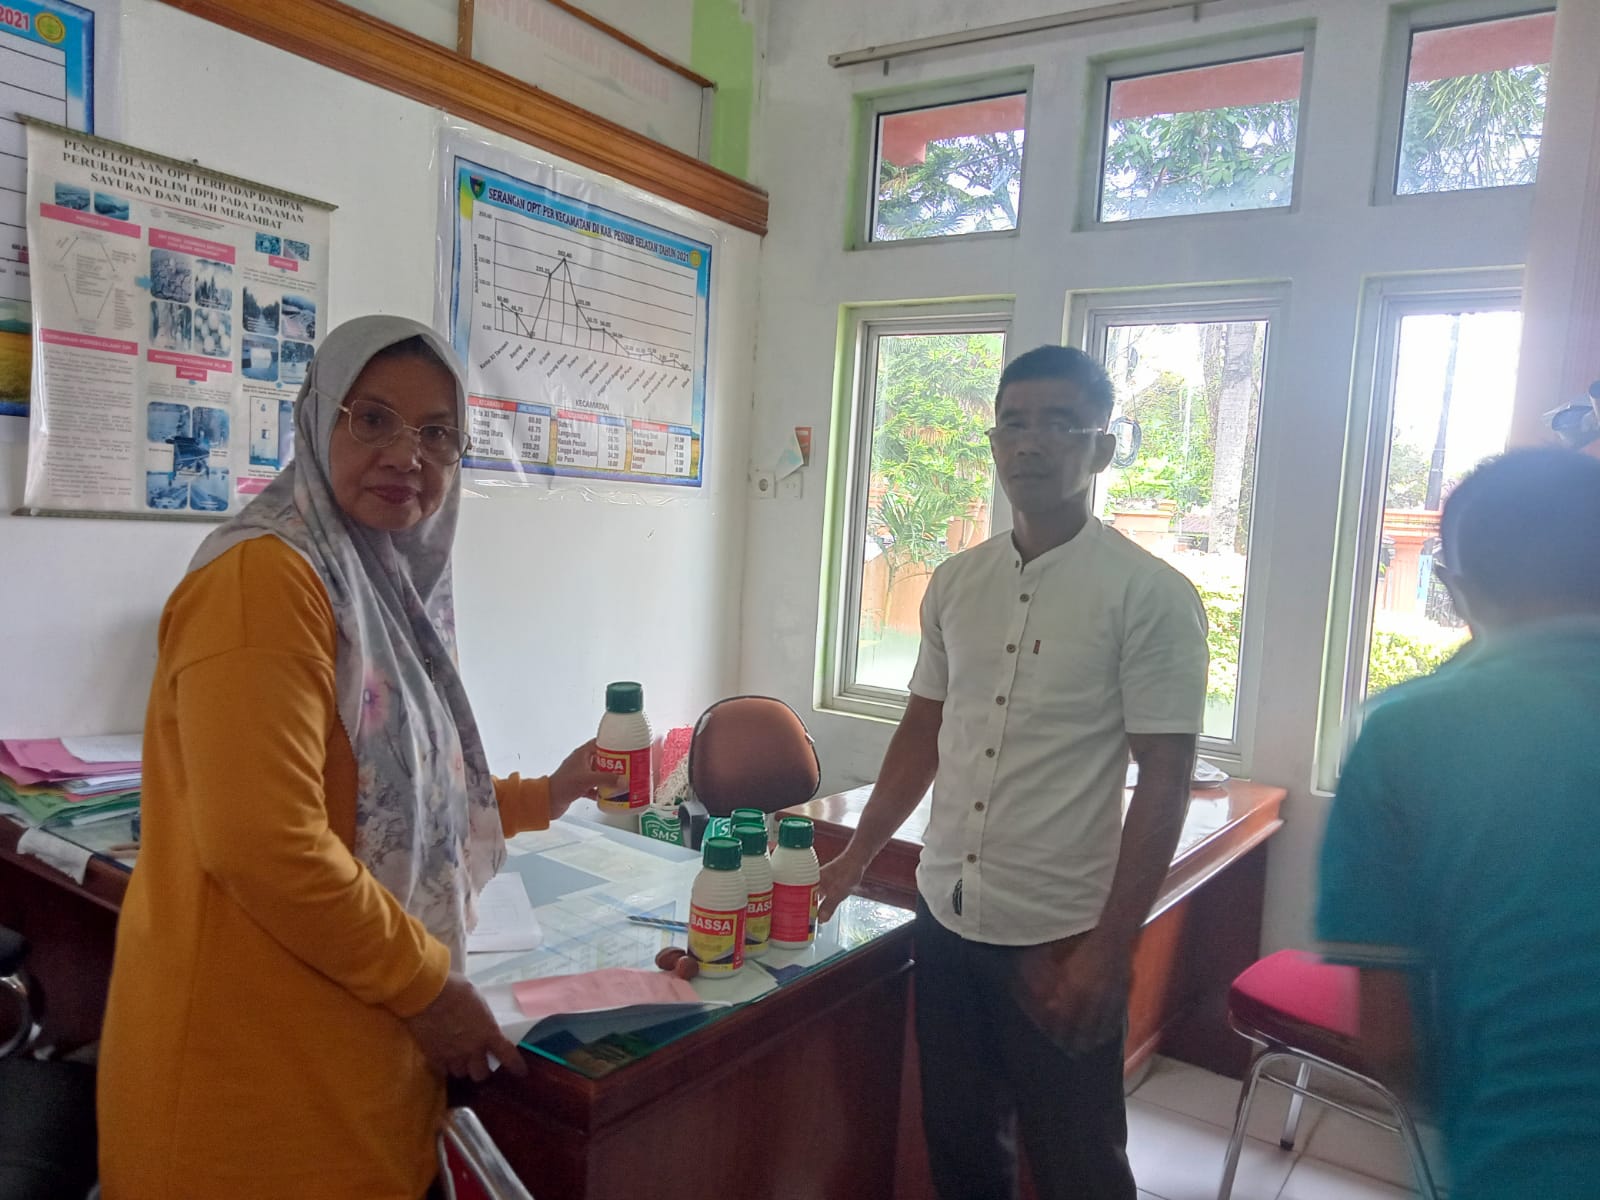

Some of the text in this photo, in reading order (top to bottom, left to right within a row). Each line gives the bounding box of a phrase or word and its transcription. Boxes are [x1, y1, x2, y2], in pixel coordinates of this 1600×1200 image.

[63, 151, 145, 181] PERUBAHAN
[149, 175, 187, 192] IKLIM
[220, 194, 249, 209] PADA
[252, 202, 304, 224] TANAMAN
[64, 139, 303, 212] PENGELOLAAN OPT TERHADAP DAMPAK
[90, 172, 151, 196] SAYURAN
[155, 189, 181, 203] DAN
[184, 196, 217, 213] BUAH
[220, 206, 283, 229] MERAMBAT
[488, 187, 525, 210] SERANGAN
[526, 201, 542, 215] OPT
[543, 205, 554, 218] PER
[555, 210, 591, 232] KECAMATAN
[592, 222, 600, 234] DI
[635, 237, 659, 253] SELATAN
[658, 245, 677, 258] TAHUN
[677, 249, 689, 263] 2021
[650, 828, 679, 842] SMS
[691, 912, 731, 931] BASSA
